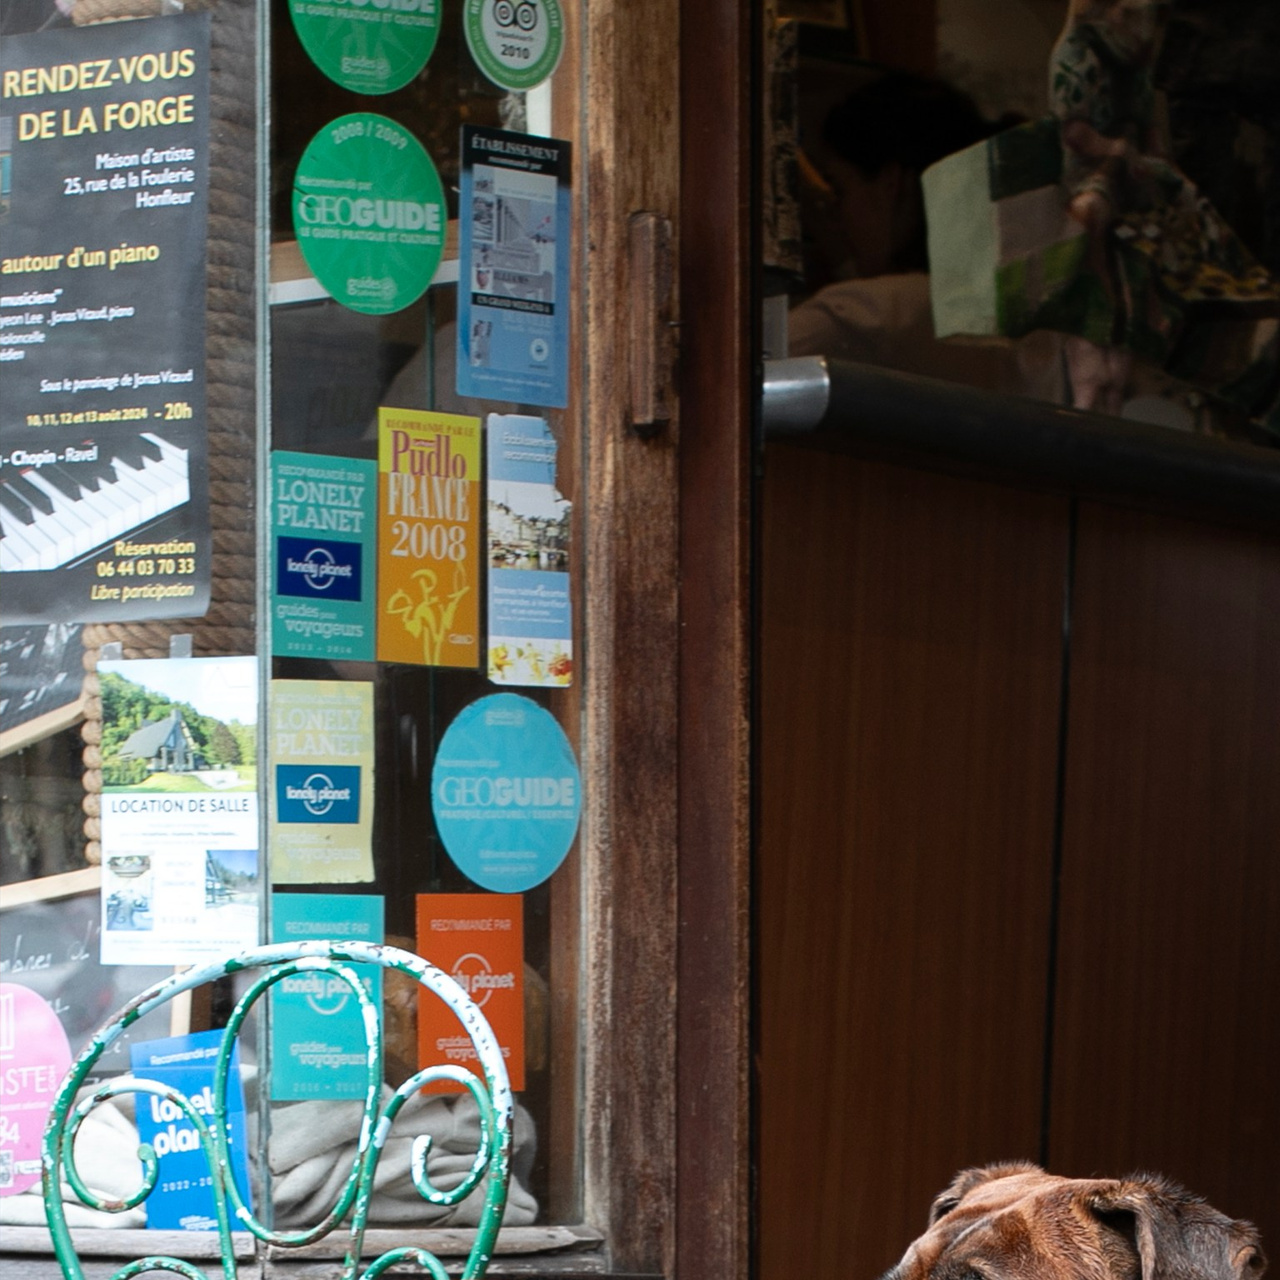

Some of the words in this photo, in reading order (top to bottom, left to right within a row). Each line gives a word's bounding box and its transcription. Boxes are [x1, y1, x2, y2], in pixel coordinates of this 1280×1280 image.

[500, 44, 530, 59] 2010
[4, 49, 195, 98] RENDEZ-VOUS
[19, 110, 56, 141] DE
[62, 107, 97, 136] LA
[104, 94, 194, 132] FORGE
[471, 133, 559, 162] ÉTABLISSEMENT
[96, 152, 139, 170] Maison
[141, 147, 195, 165] d'artiste
[85, 178, 108, 192] rue
[110, 174, 126, 189] de
[128, 171, 139, 187] la
[141, 167, 195, 187] Foulerie
[136, 190, 195, 208] Honfleur
[1, 254, 64, 274] autour
[67, 246, 106, 268] d'un
[109, 244, 160, 271] piano
[0, 331, 46, 345] ioloncelle
[164, 402, 193, 421] 20h
[386, 419, 444, 433] RECOMMANDÉ
[10, 448, 56, 468] Chopin
[65, 445, 98, 463] Ravel
[391, 430, 467, 479] Pudlo
[278, 465, 346, 482] RECOMMANDÉ
[277, 479, 365, 508] LONELY
[388, 472, 470, 522] FRANCE
[277, 503, 365, 533] PLANET
[115, 538, 196, 556] Réservation
[391, 521, 467, 561] 2008
[97, 561, 115, 577] 06
[116, 560, 135, 576] 44
[137, 559, 155, 575] 03
[157, 558, 175, 574] 70
[177, 557, 195, 574] 33
[286, 558, 318, 578] lonely
[318, 561, 352, 578] planet
[91, 584, 120, 600] Libre
[121, 581, 195, 603] participation
[277, 603, 319, 619] guides
[285, 618, 364, 639] voyageurs
[276, 708, 362, 731] LONELY
[276, 733, 362, 756] PLANET
[286, 785, 318, 803] lonely
[318, 787, 351, 803] planet
[111, 799, 183, 814] LOCATION
[188, 798, 206, 813] DE
[209, 798, 250, 812] SALLE
[285, 921, 350, 934] RECOMMANDÉ
[352, 923, 370, 935] PAR
[430, 919, 492, 931] RECOMMANDÉ
[494, 919, 511, 931] PAR
[282, 976, 324, 999] lonely
[472, 970, 516, 994] planet
[150, 1051, 205, 1065] Recommandé
[300, 1053, 366, 1069] voyageurs
